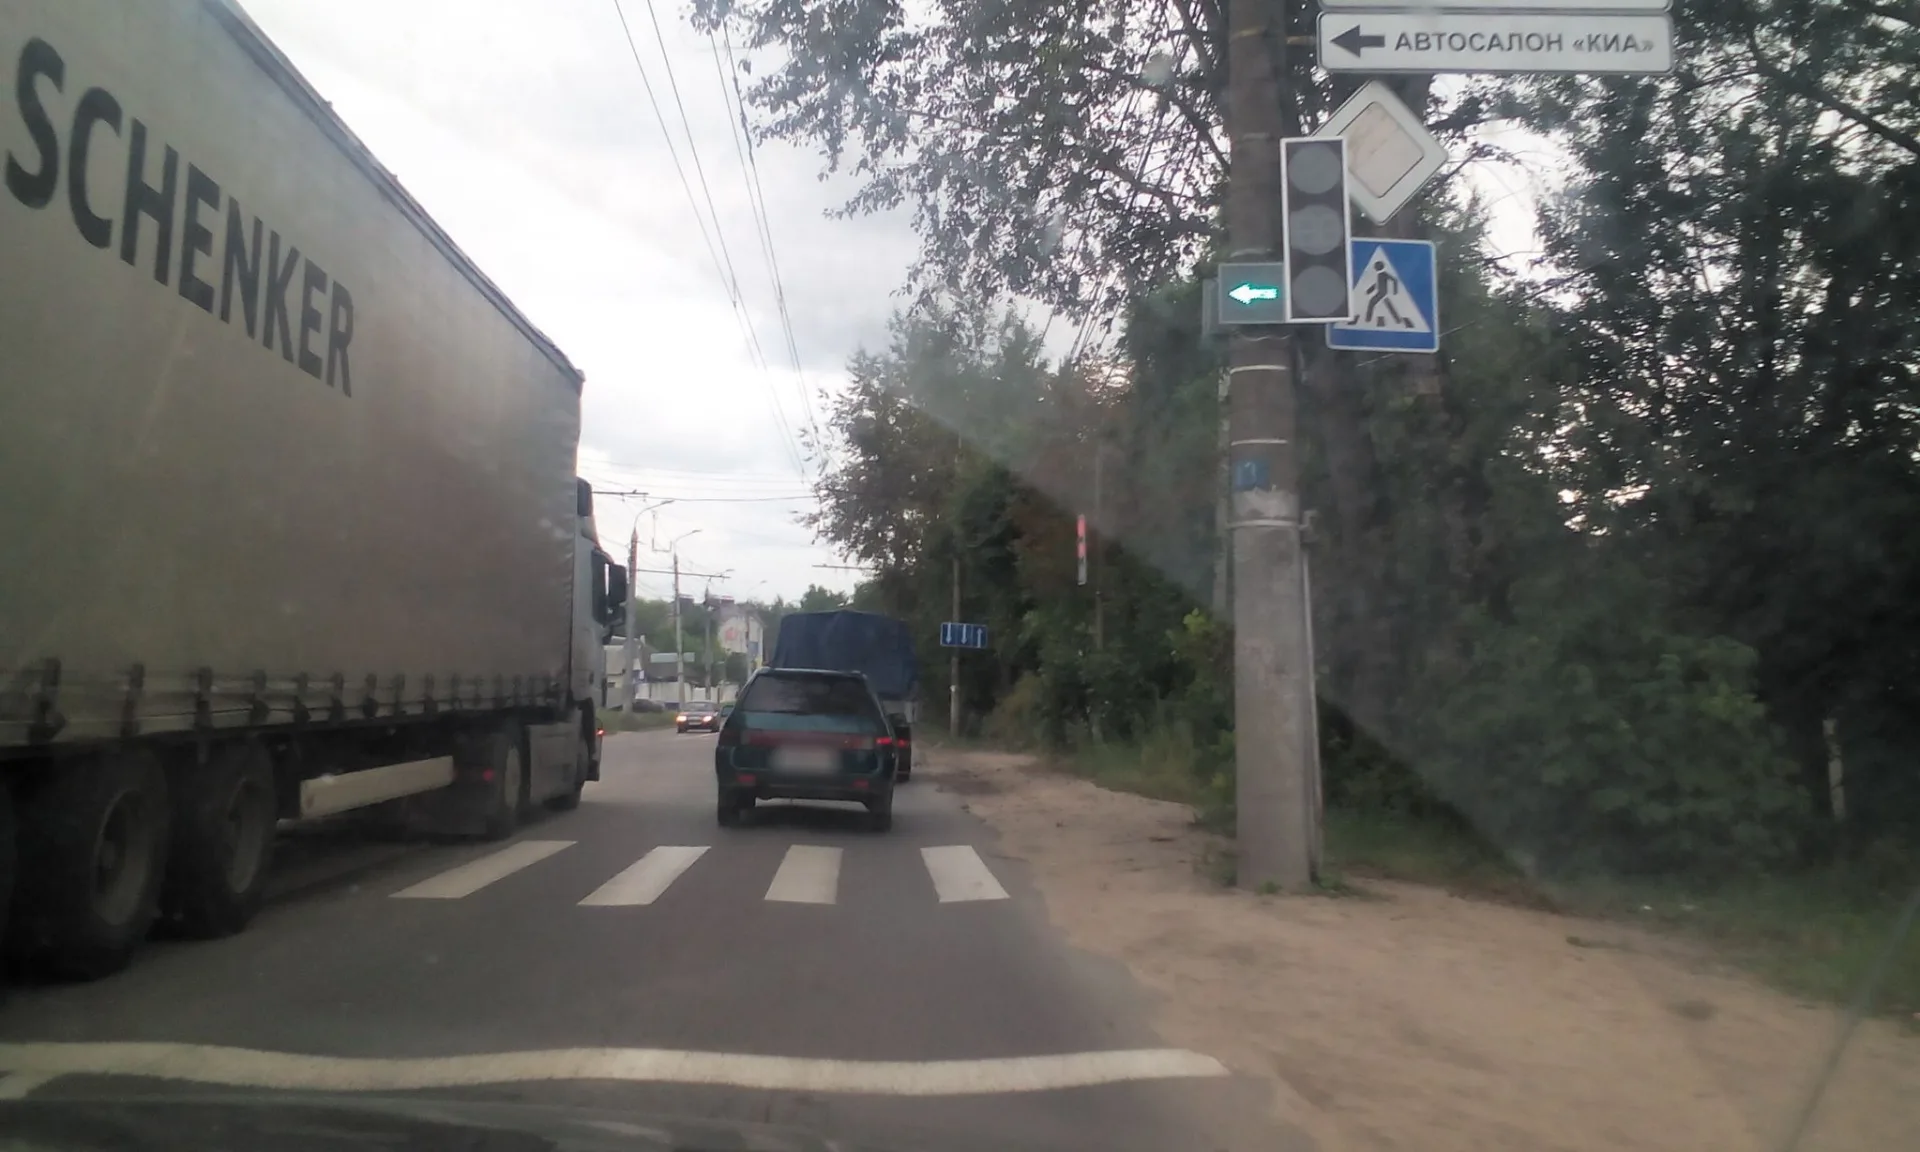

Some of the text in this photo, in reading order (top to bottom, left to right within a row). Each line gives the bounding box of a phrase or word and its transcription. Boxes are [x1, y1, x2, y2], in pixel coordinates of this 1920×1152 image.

[1395, 32, 1655, 53] АВТОСАЛОН «КИА»
[5, 37, 355, 398] SCHENKER
